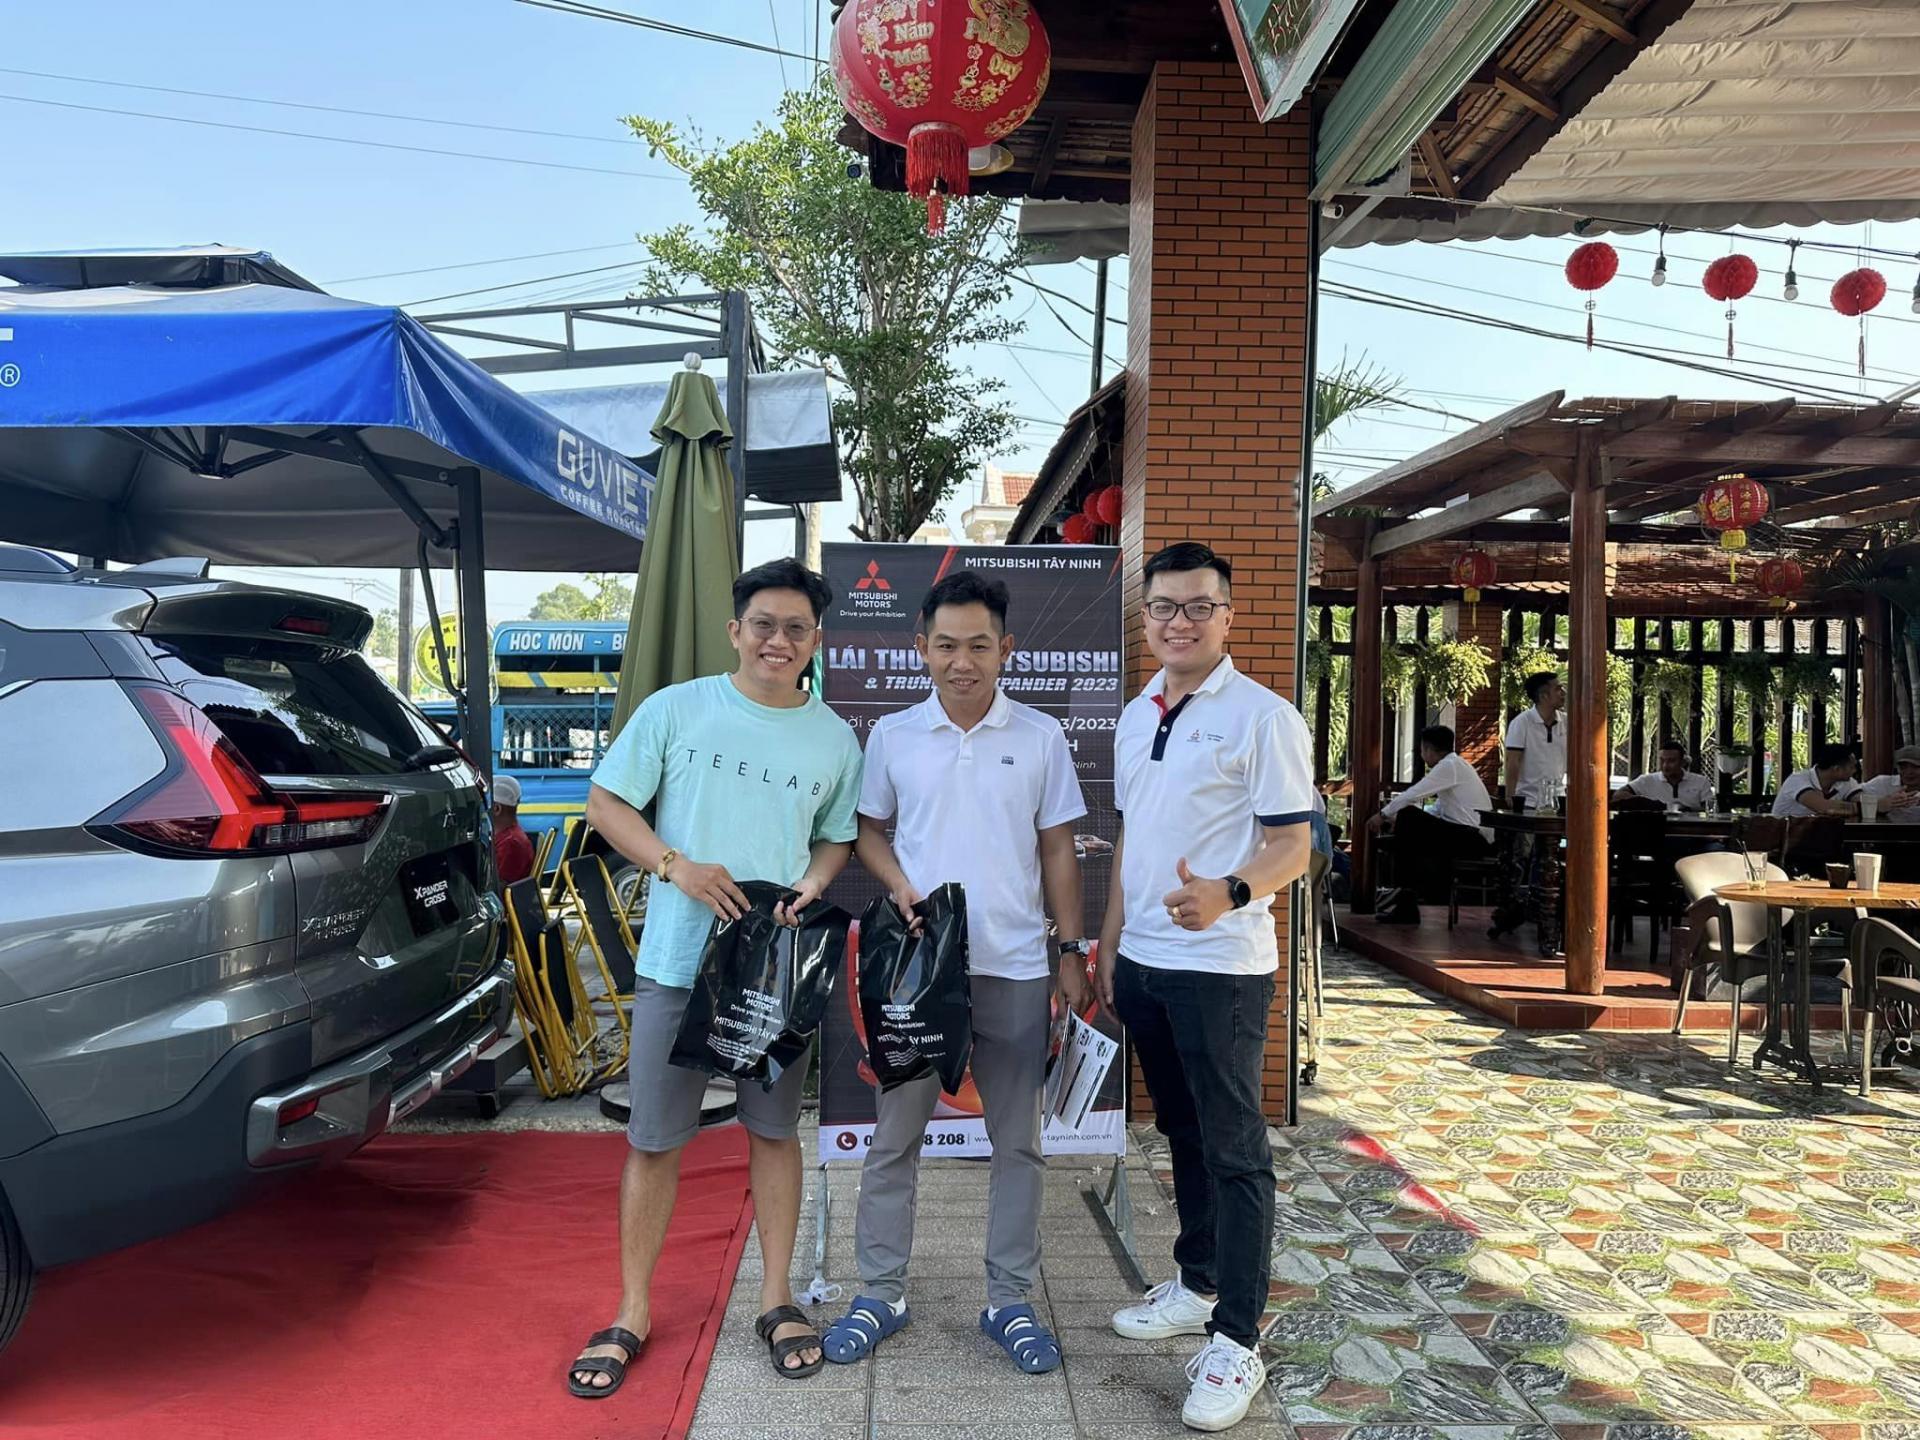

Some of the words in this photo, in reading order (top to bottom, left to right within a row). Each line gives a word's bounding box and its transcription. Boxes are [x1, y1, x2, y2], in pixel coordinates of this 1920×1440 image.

[557, 428, 655, 520] GUVIET
[965, 557, 1040, 569] MITSUBISHI
[1043, 556, 1066, 569] TÂY
[1069, 559, 1101, 569] NINH
[848, 592, 898, 600] MITSUBISHI
[855, 600, 891, 609] MOTORS
[828, 645, 866, 670] LÁI
[1004, 650, 1118, 672] TSUBISHI
[865, 677, 878, 689] &
[885, 674, 936, 690] TRƯN
[1071, 678, 1118, 691] 2023
[1060, 716, 1117, 731] 3/2023
[687, 749, 821, 796] TEELAB
[413, 880, 448, 900] XPANDER
[424, 892, 447, 908] CROSS
[742, 988, 780, 1006] MITSUBISHI
[731, 1003, 746, 1014] Drive
[745, 998, 774, 1012] MOTORS
[714, 1015, 758, 1034] MITSUBISHI
[921, 1033, 944, 1044] NINH
[937, 1133, 965, 1145] 208
